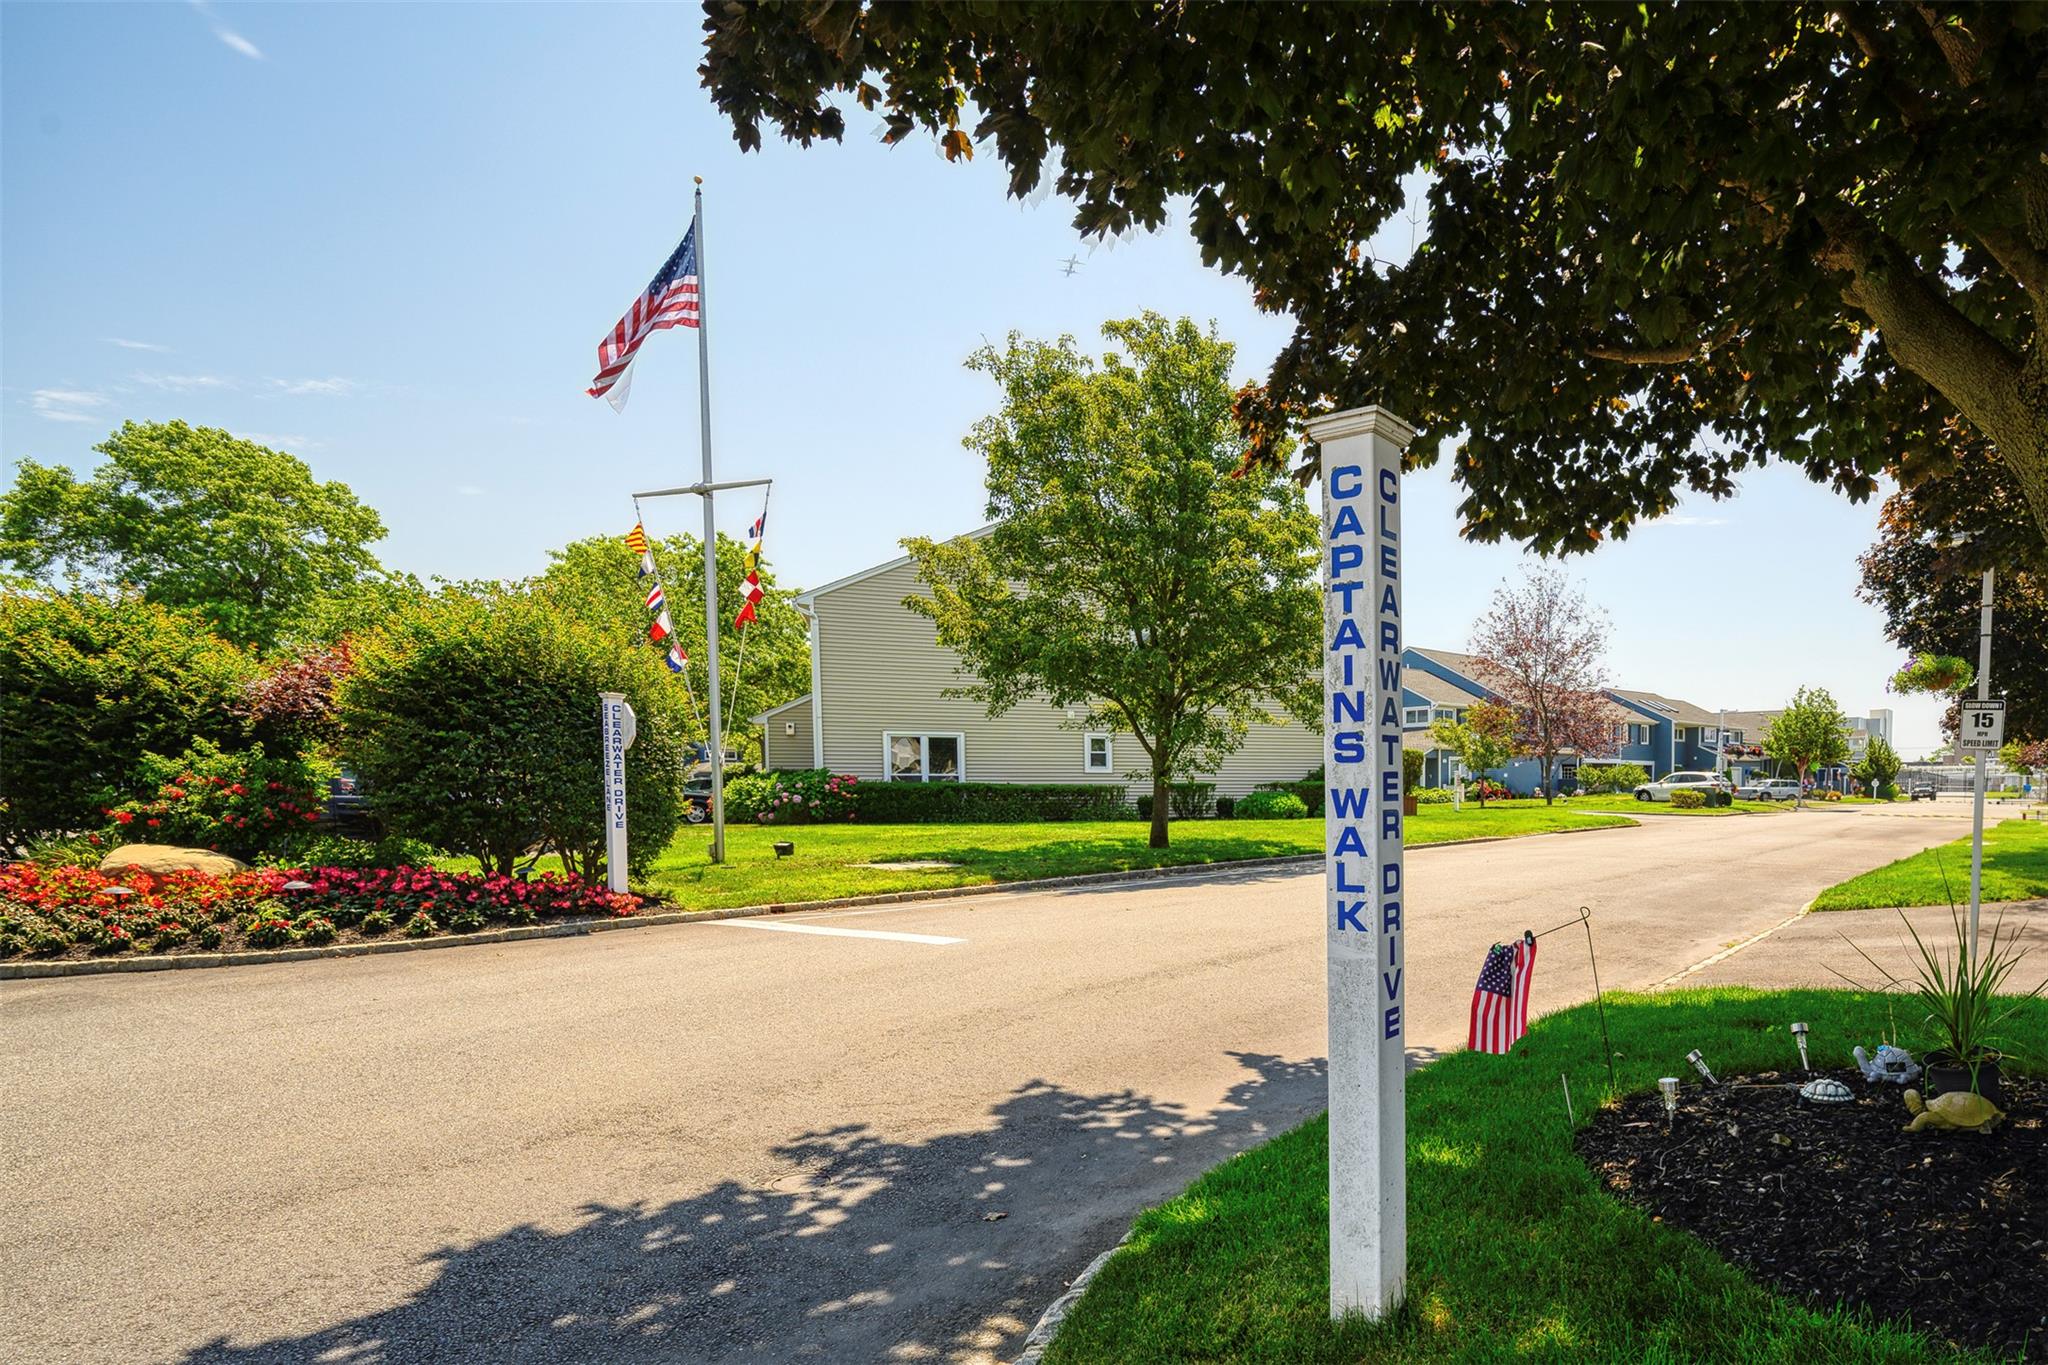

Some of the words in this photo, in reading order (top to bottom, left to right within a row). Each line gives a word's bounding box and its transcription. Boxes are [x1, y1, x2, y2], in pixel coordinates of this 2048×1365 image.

[1330, 465, 1366, 763] CAPTAINS
[1379, 468, 1399, 840] CLEARWATER
[612, 705, 623, 785] CLEARWATER
[1971, 713, 1994, 728] 15
[614, 789, 624, 829] DRIVE
[1331, 788, 1369, 932] WALK
[1383, 863, 1401, 1040] DRIVE
